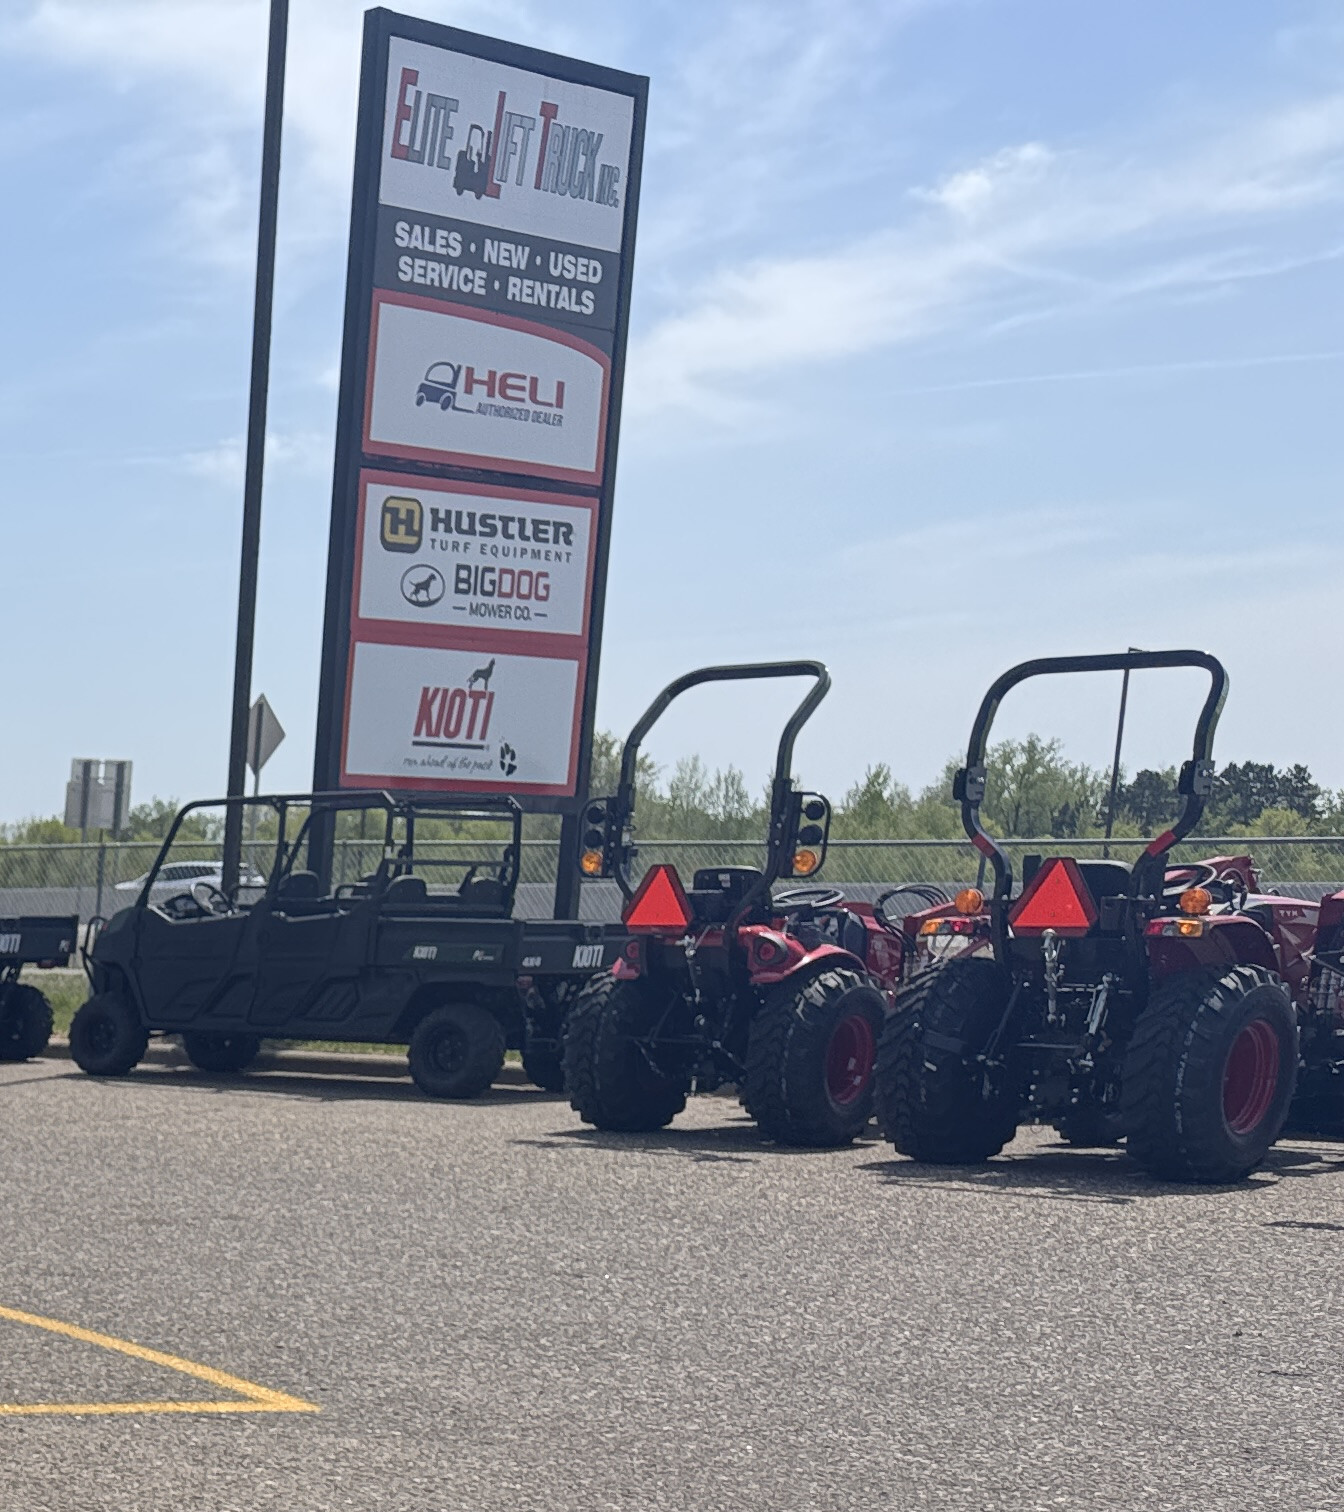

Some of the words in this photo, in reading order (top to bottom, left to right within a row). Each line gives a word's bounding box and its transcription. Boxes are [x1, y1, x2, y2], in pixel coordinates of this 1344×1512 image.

[391, 67, 459, 170] ELITE
[484, 91, 536, 199] LIFT
[534, 101, 604, 202] TRUCK
[395, 221, 462, 257] SALES
[483, 238, 530, 270] NEW
[549, 252, 602, 284] USED
[398, 255, 487, 295] SERVICE
[507, 276, 595, 315] RENTALS
[464, 367, 565, 409] HELI
[476, 402, 530, 422] AUTHORIZED
[531, 410, 564, 427] DEALER
[430, 507, 574, 546] HUSTLER
[430, 538, 471, 554] TURF
[480, 543, 572, 563] EQUIPMENT
[468, 602, 511, 619] MOWER
[413, 687, 495, 740] KIOTI
[572, 944, 605, 968] KIOTI
